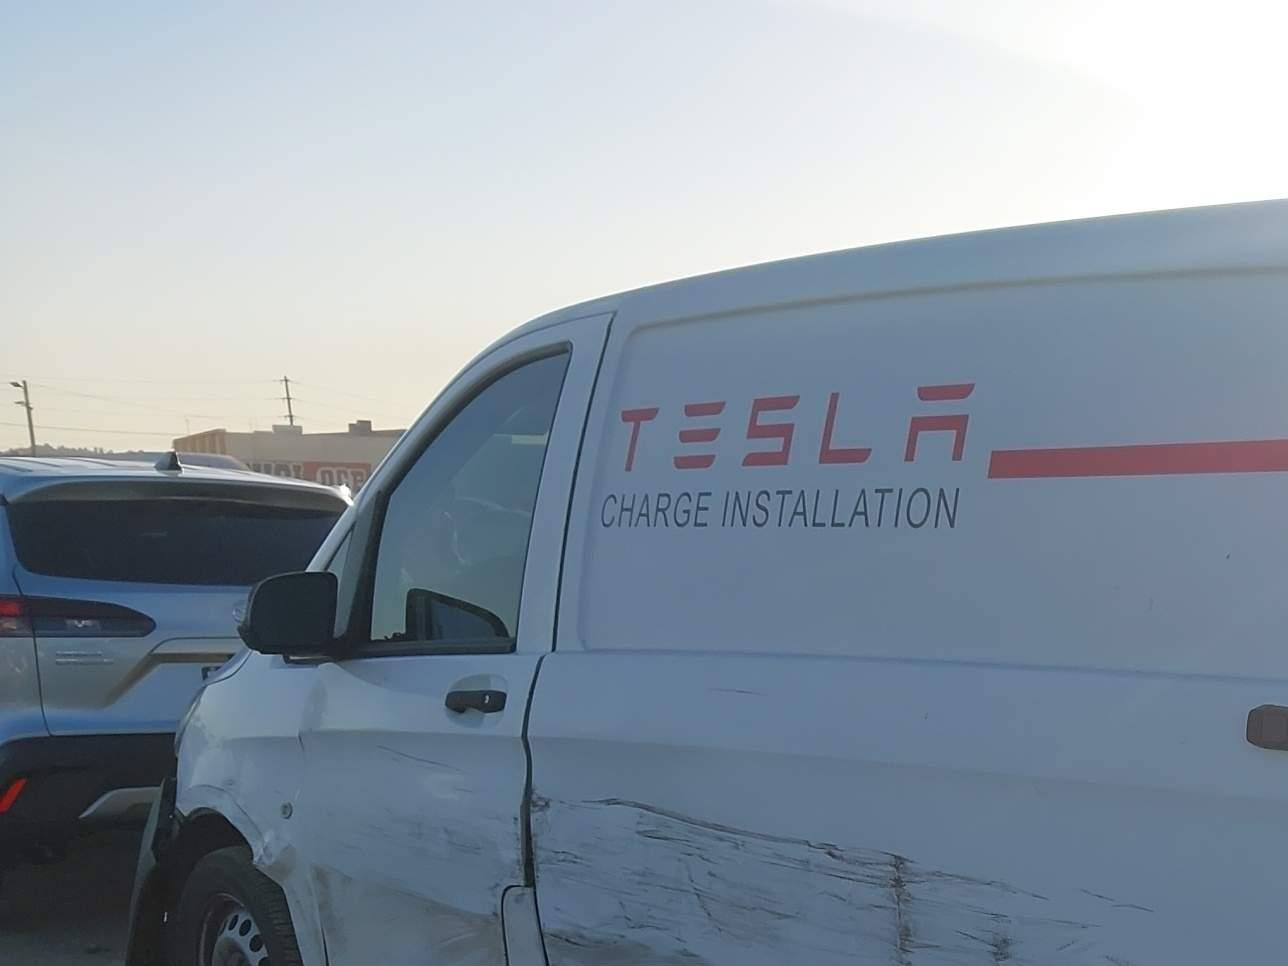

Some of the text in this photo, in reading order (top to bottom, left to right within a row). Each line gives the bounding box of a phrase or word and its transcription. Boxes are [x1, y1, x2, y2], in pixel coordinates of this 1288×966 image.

[620, 383, 976, 472] TESLA
[601, 487, 960, 529] CHARGE INSTALLATION
